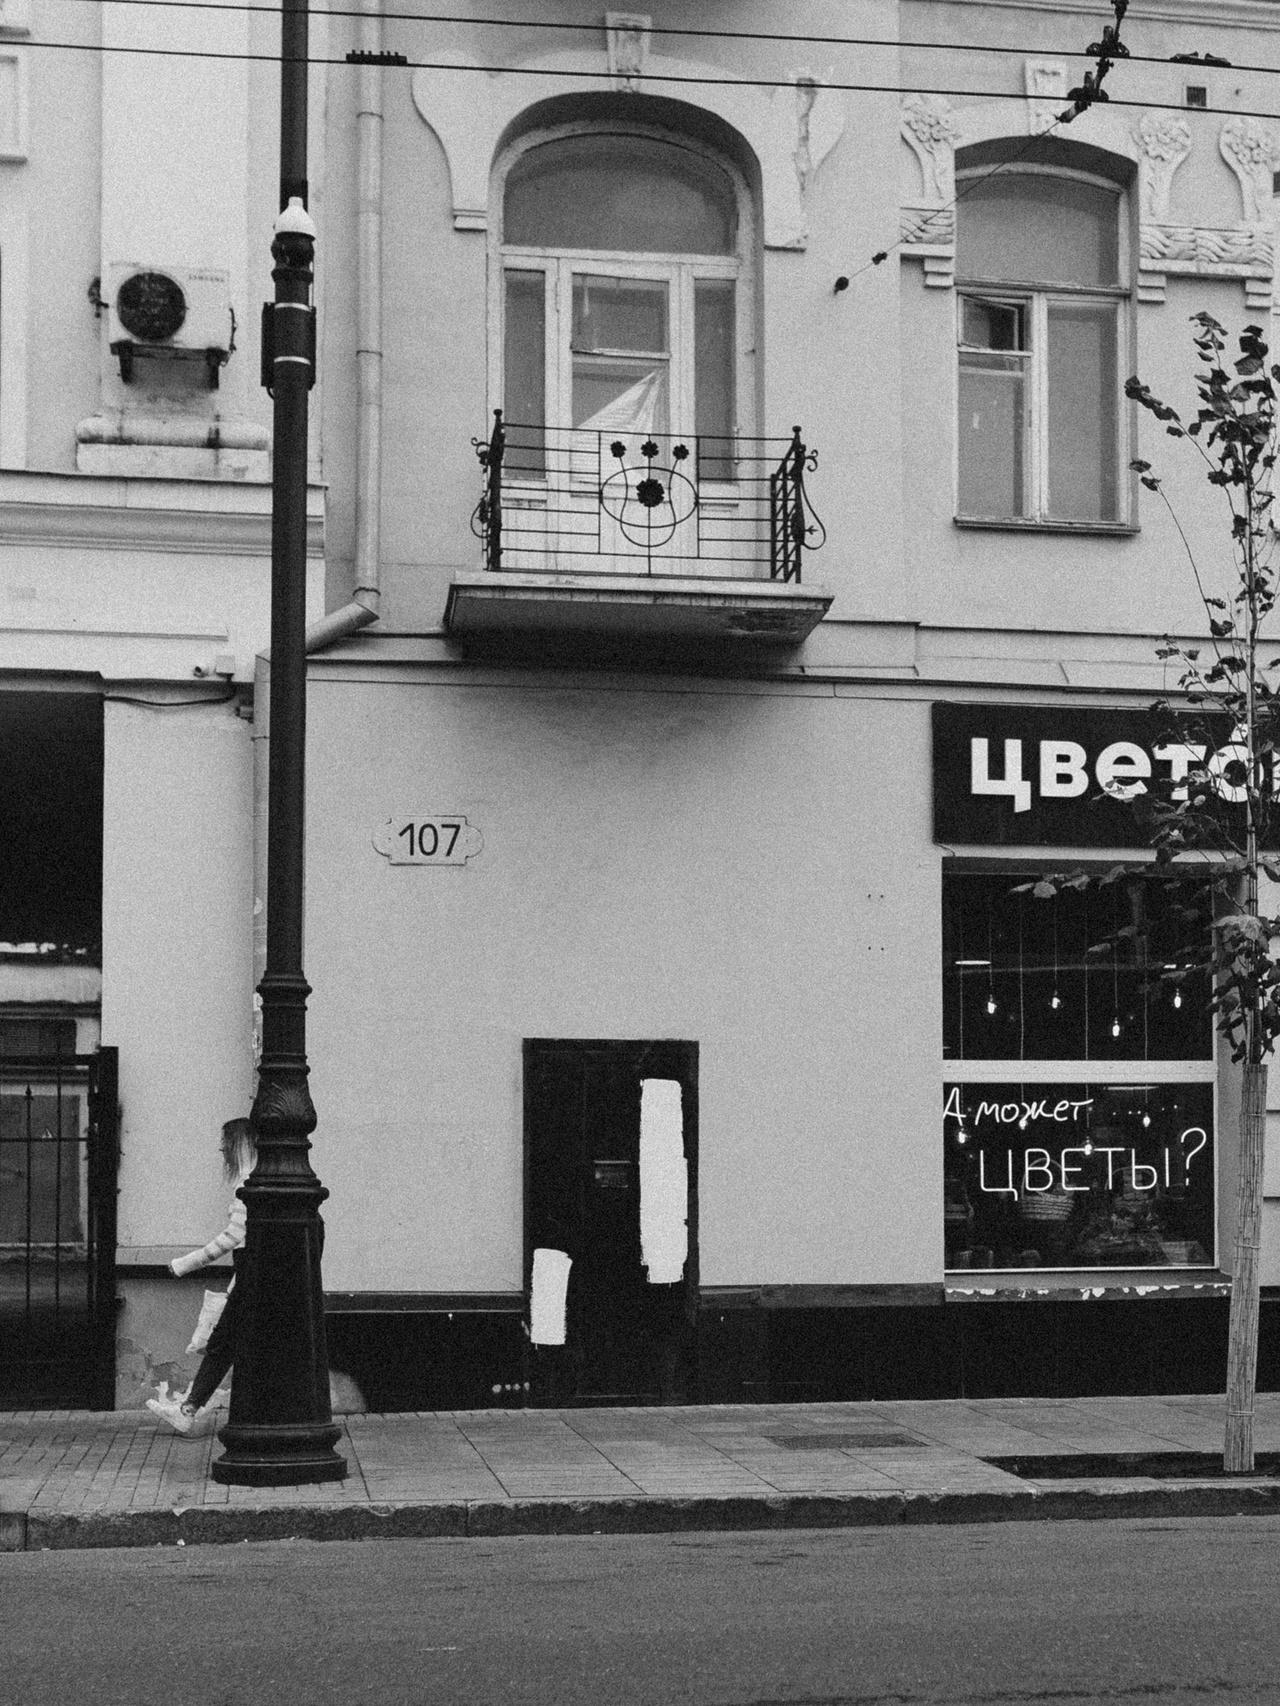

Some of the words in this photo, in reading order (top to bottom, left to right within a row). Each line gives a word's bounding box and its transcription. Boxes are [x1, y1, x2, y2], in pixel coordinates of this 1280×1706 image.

[398, 823, 461, 857] 107
[942, 1087, 967, 1126] А
[975, 1099, 1094, 1126] может
[979, 1127, 1207, 1201] ЦВЕТЫ?
